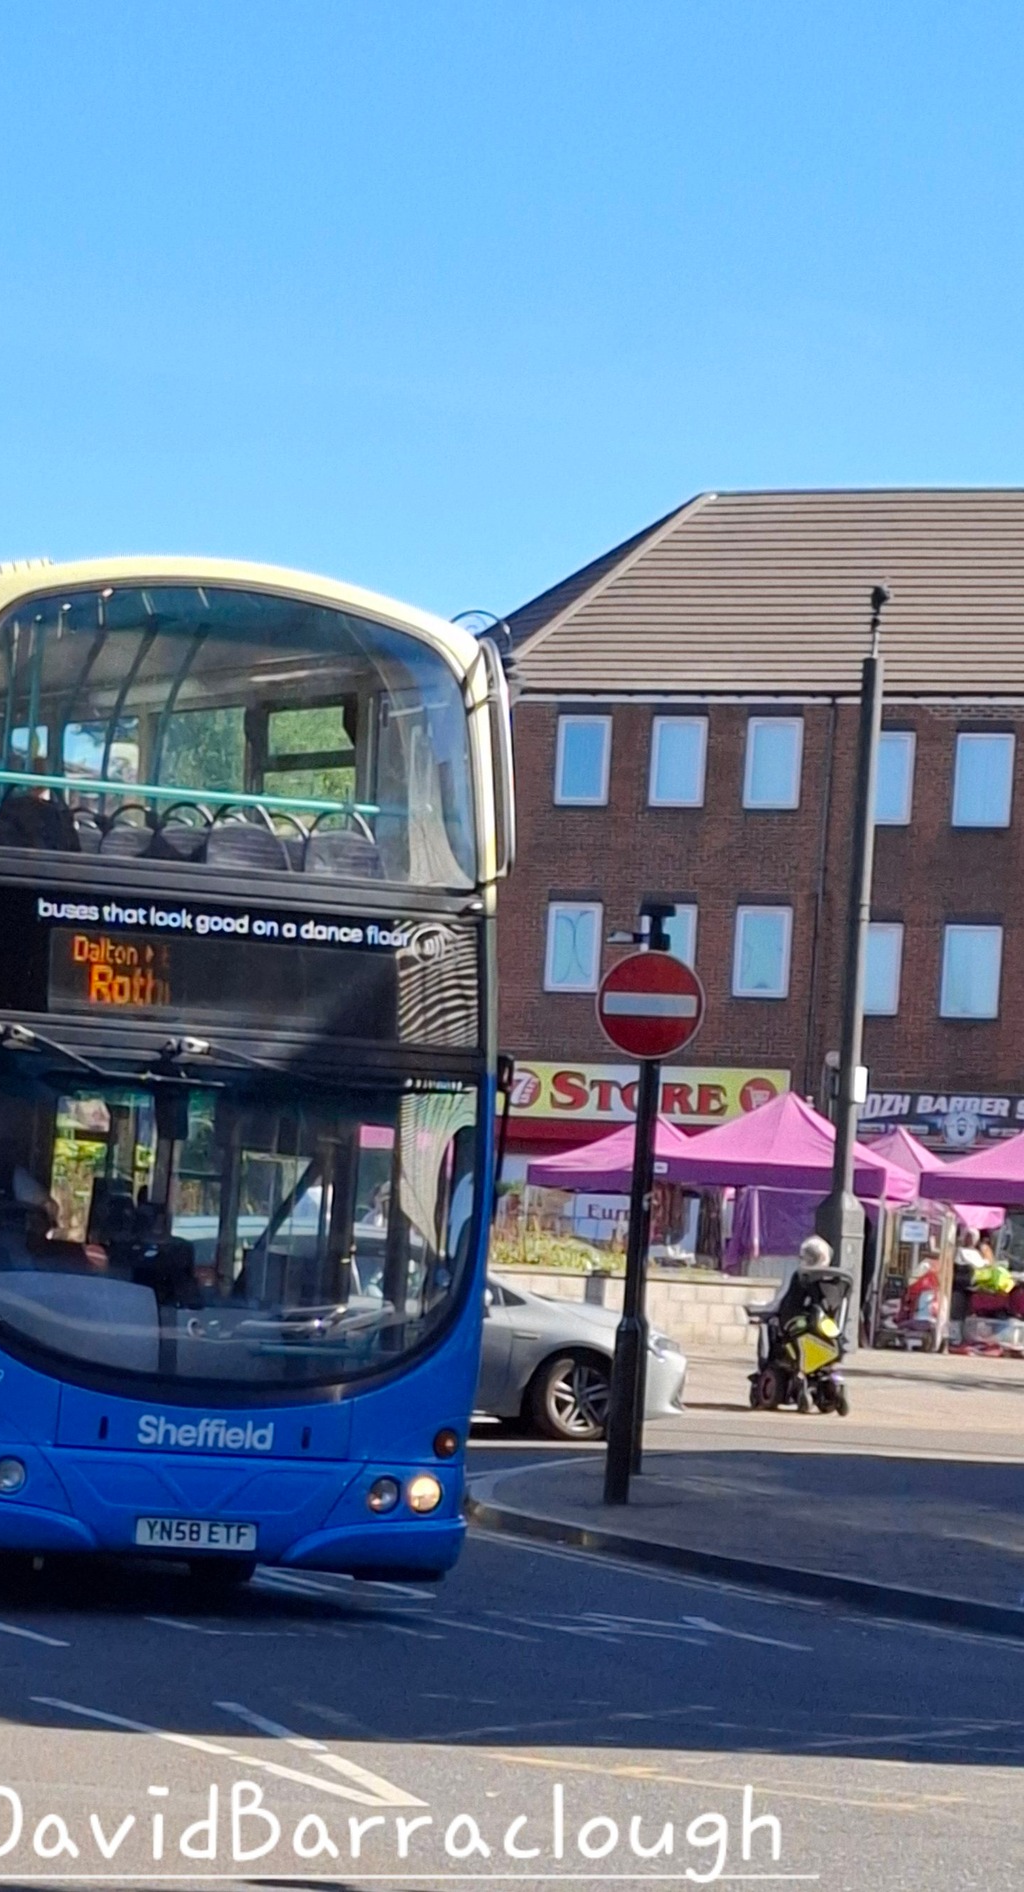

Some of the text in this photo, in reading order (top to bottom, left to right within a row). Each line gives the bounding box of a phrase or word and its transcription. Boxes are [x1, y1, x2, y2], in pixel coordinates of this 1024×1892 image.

[38, 898, 411, 947] buses that look good on a dance floor
[73, 935, 139, 966] Dalton
[137, 1414, 274, 1451] Sheffield
[146, 1519, 251, 1545] YN58 ETF
